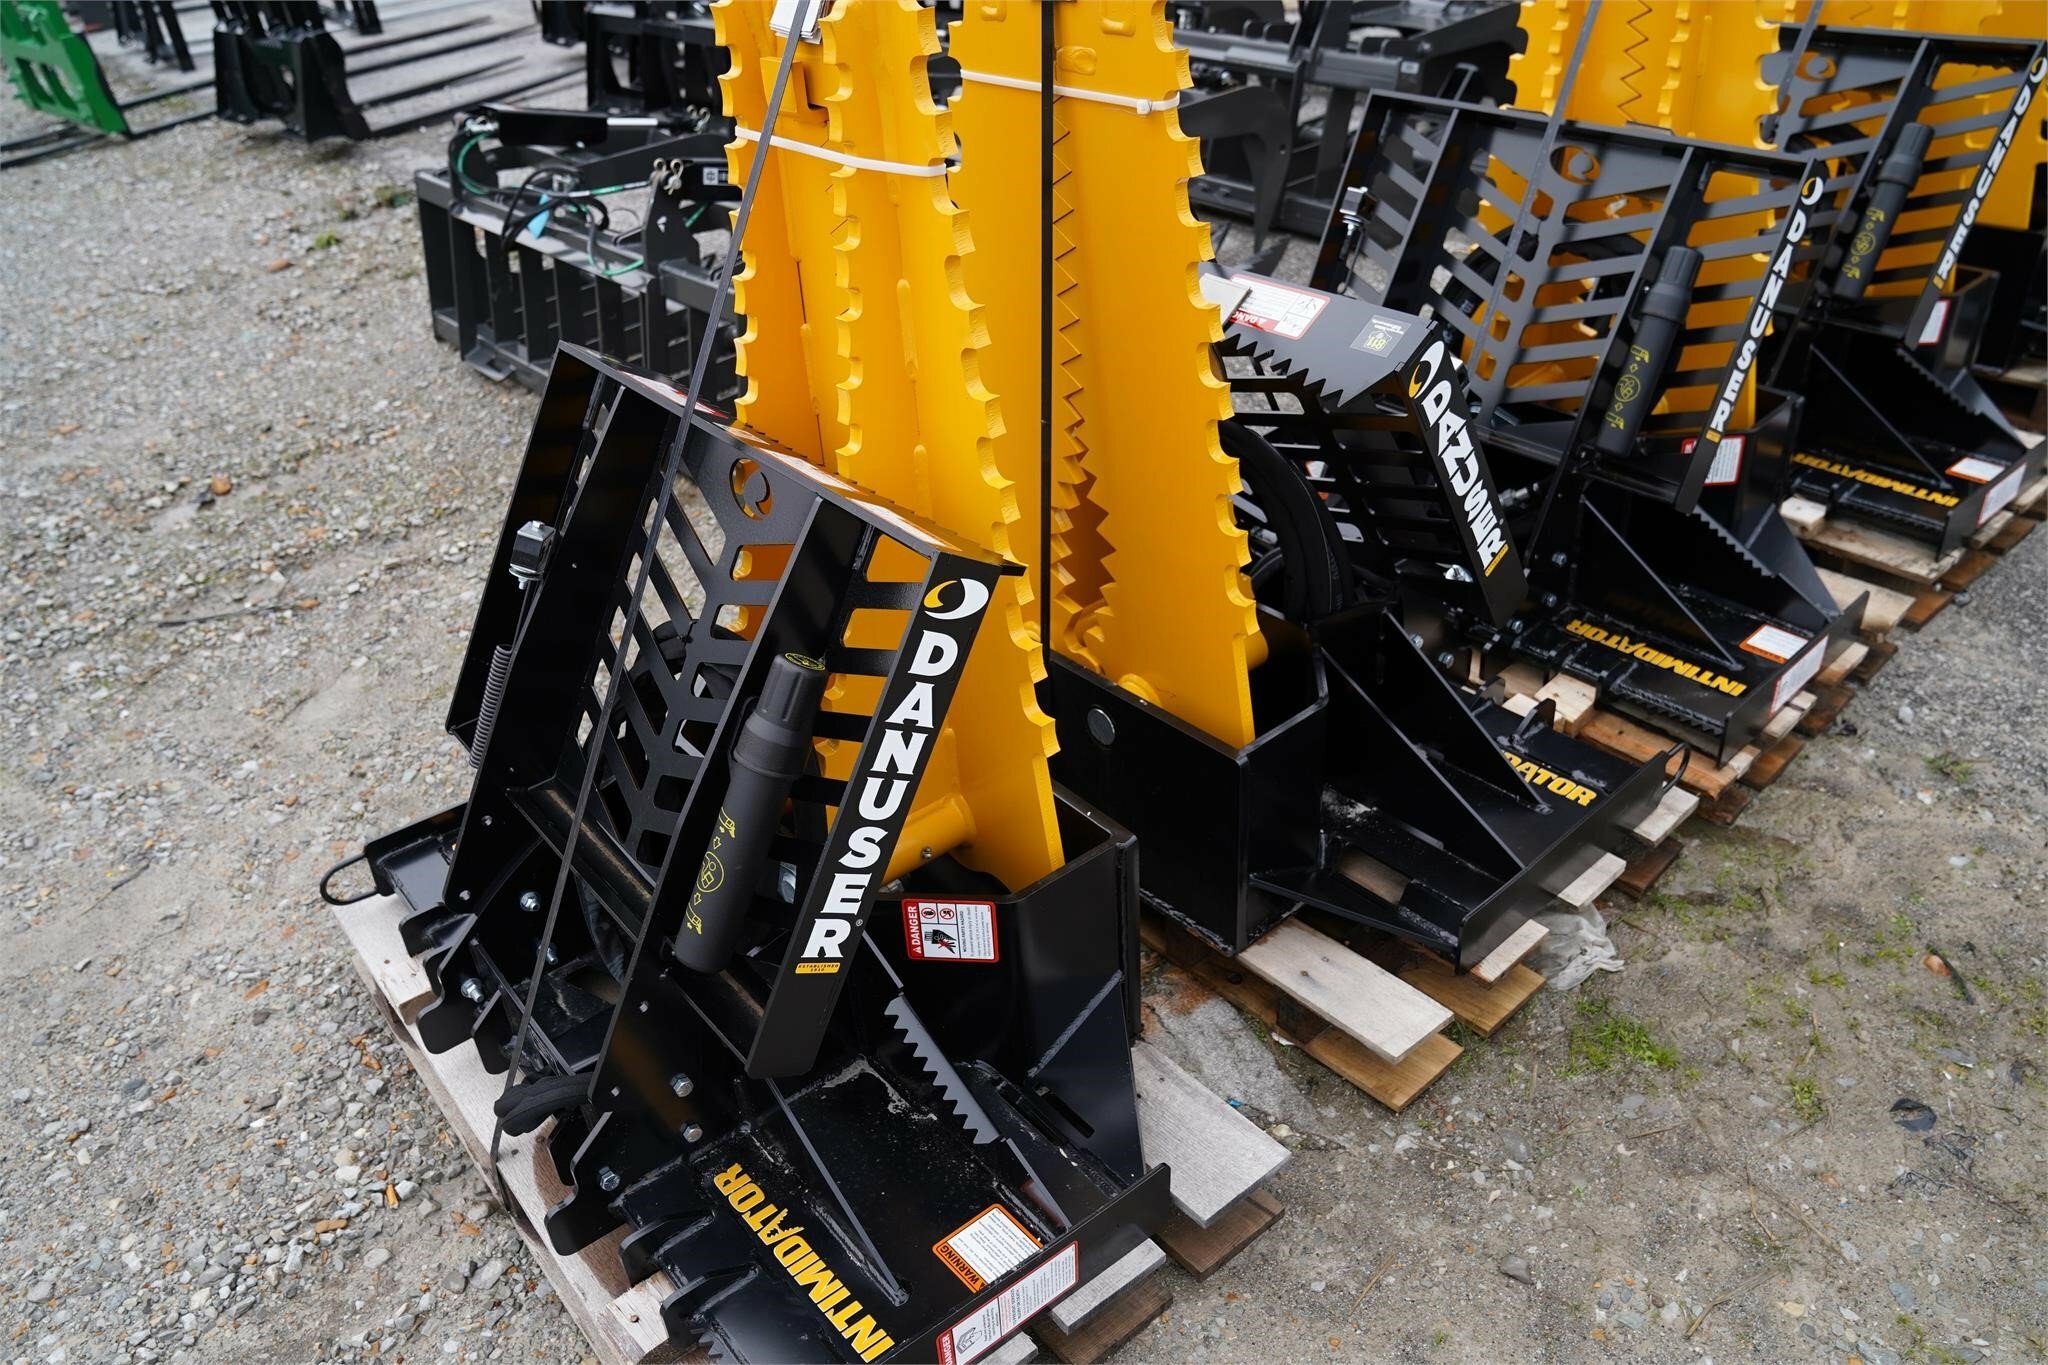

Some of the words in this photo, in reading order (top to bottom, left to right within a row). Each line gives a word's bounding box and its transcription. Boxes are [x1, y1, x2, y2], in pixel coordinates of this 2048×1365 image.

[1937, 84, 2031, 280] DANUSER
[1710, 209, 1806, 433] DANUSER
[1421, 380, 1506, 570] DANUSER
[1793, 453, 1960, 507] INTIMIDATOR
[1566, 618, 1748, 697] INTIMIDATOR
[801, 629, 958, 958] DANUSER
[907, 906, 921, 945] DANGER
[713, 1162, 895, 1363] INTIMIDATOR
[940, 1245, 979, 1285] WARNING
